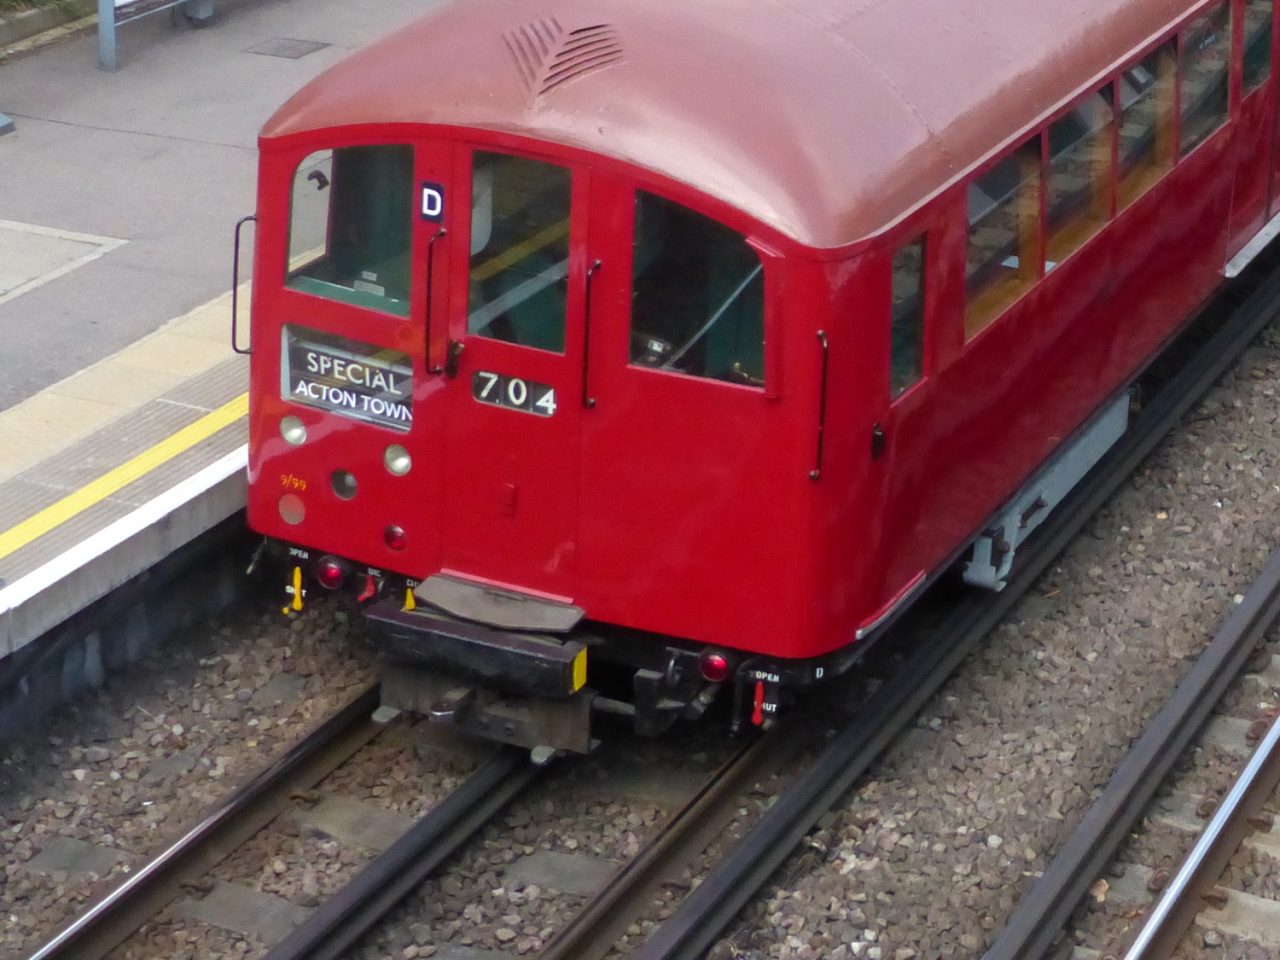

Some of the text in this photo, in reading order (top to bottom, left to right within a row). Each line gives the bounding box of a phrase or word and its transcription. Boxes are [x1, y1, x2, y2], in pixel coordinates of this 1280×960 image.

[423, 188, 441, 215] D
[306, 352, 402, 395] SPECIAL
[479, 371, 557, 415] 704
[295, 380, 413, 421] ACTON TOWN
[755, 671, 780, 682] OPEN
